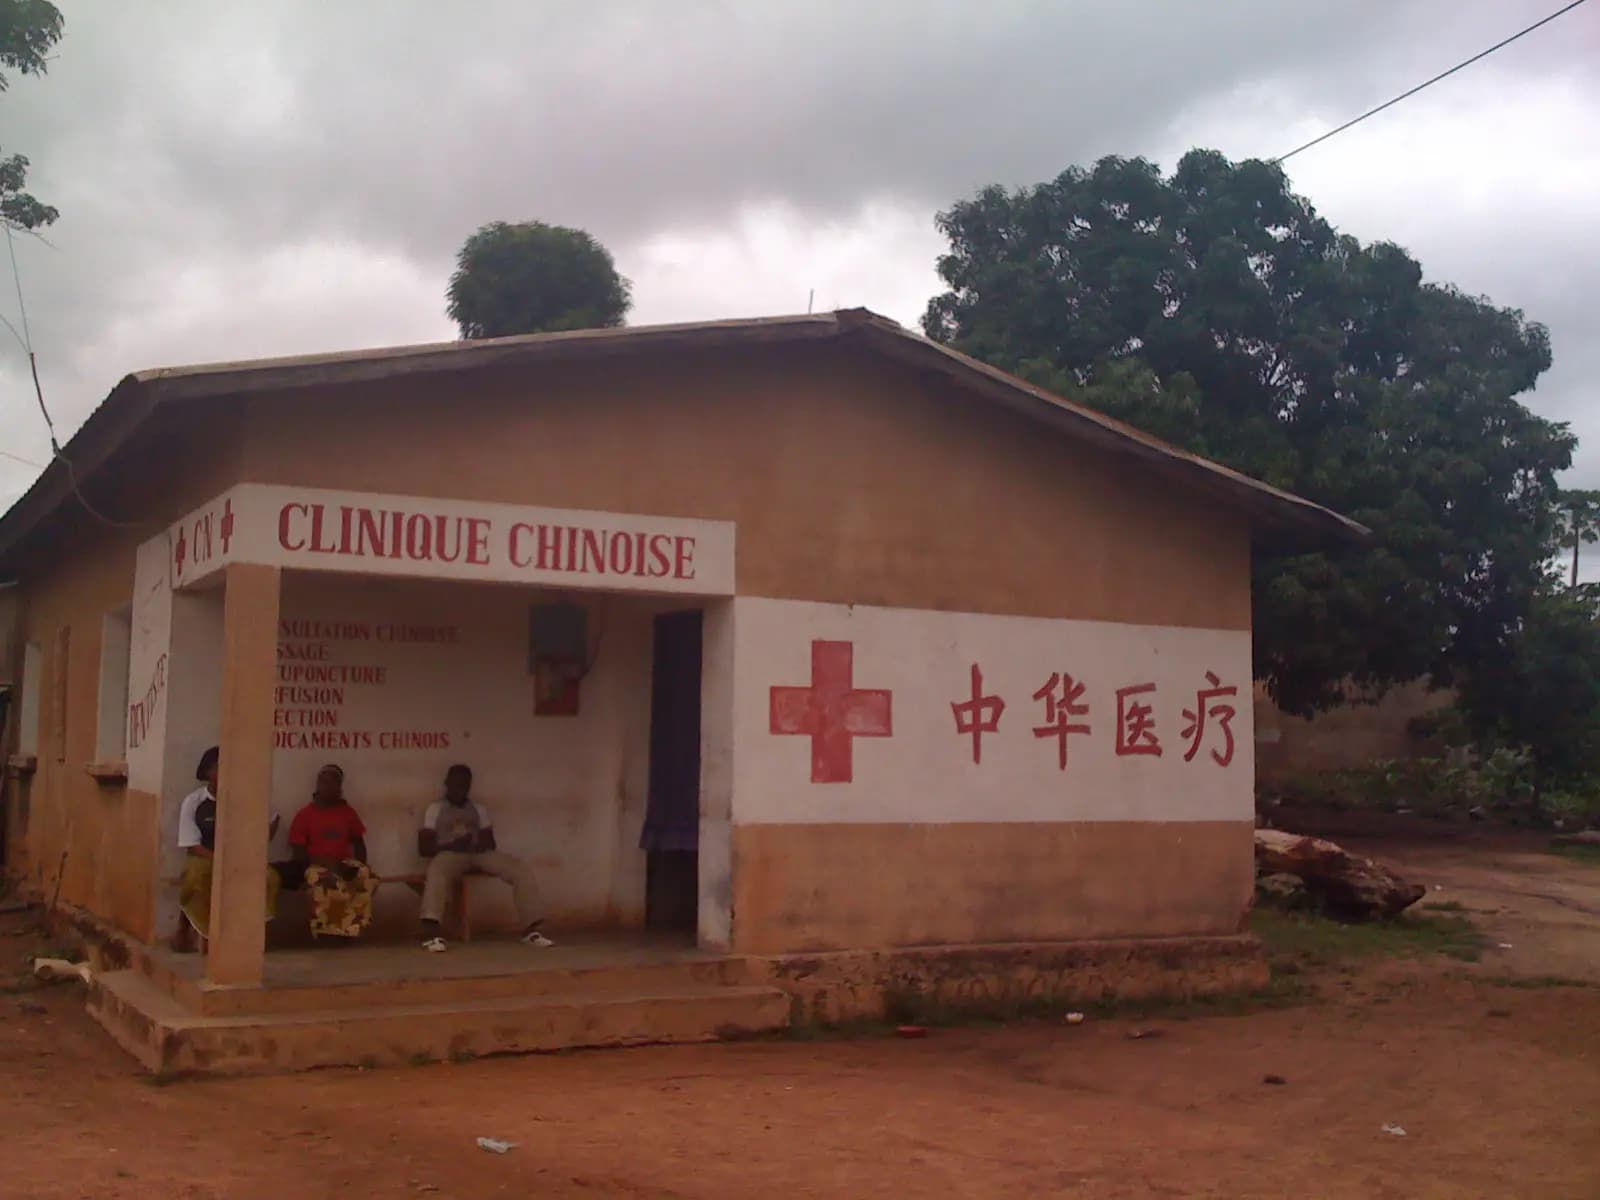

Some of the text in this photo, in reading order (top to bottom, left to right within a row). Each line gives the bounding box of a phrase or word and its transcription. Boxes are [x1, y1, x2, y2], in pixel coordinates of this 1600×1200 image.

[193, 511, 214, 565] CN
[278, 502, 696, 579] CLINIQUE CHINOISE
[277, 664, 387, 684] UPONCTURE
[379, 731, 449, 749] CHINOIS
[950, 662, 1238, 771] 中华医疗
